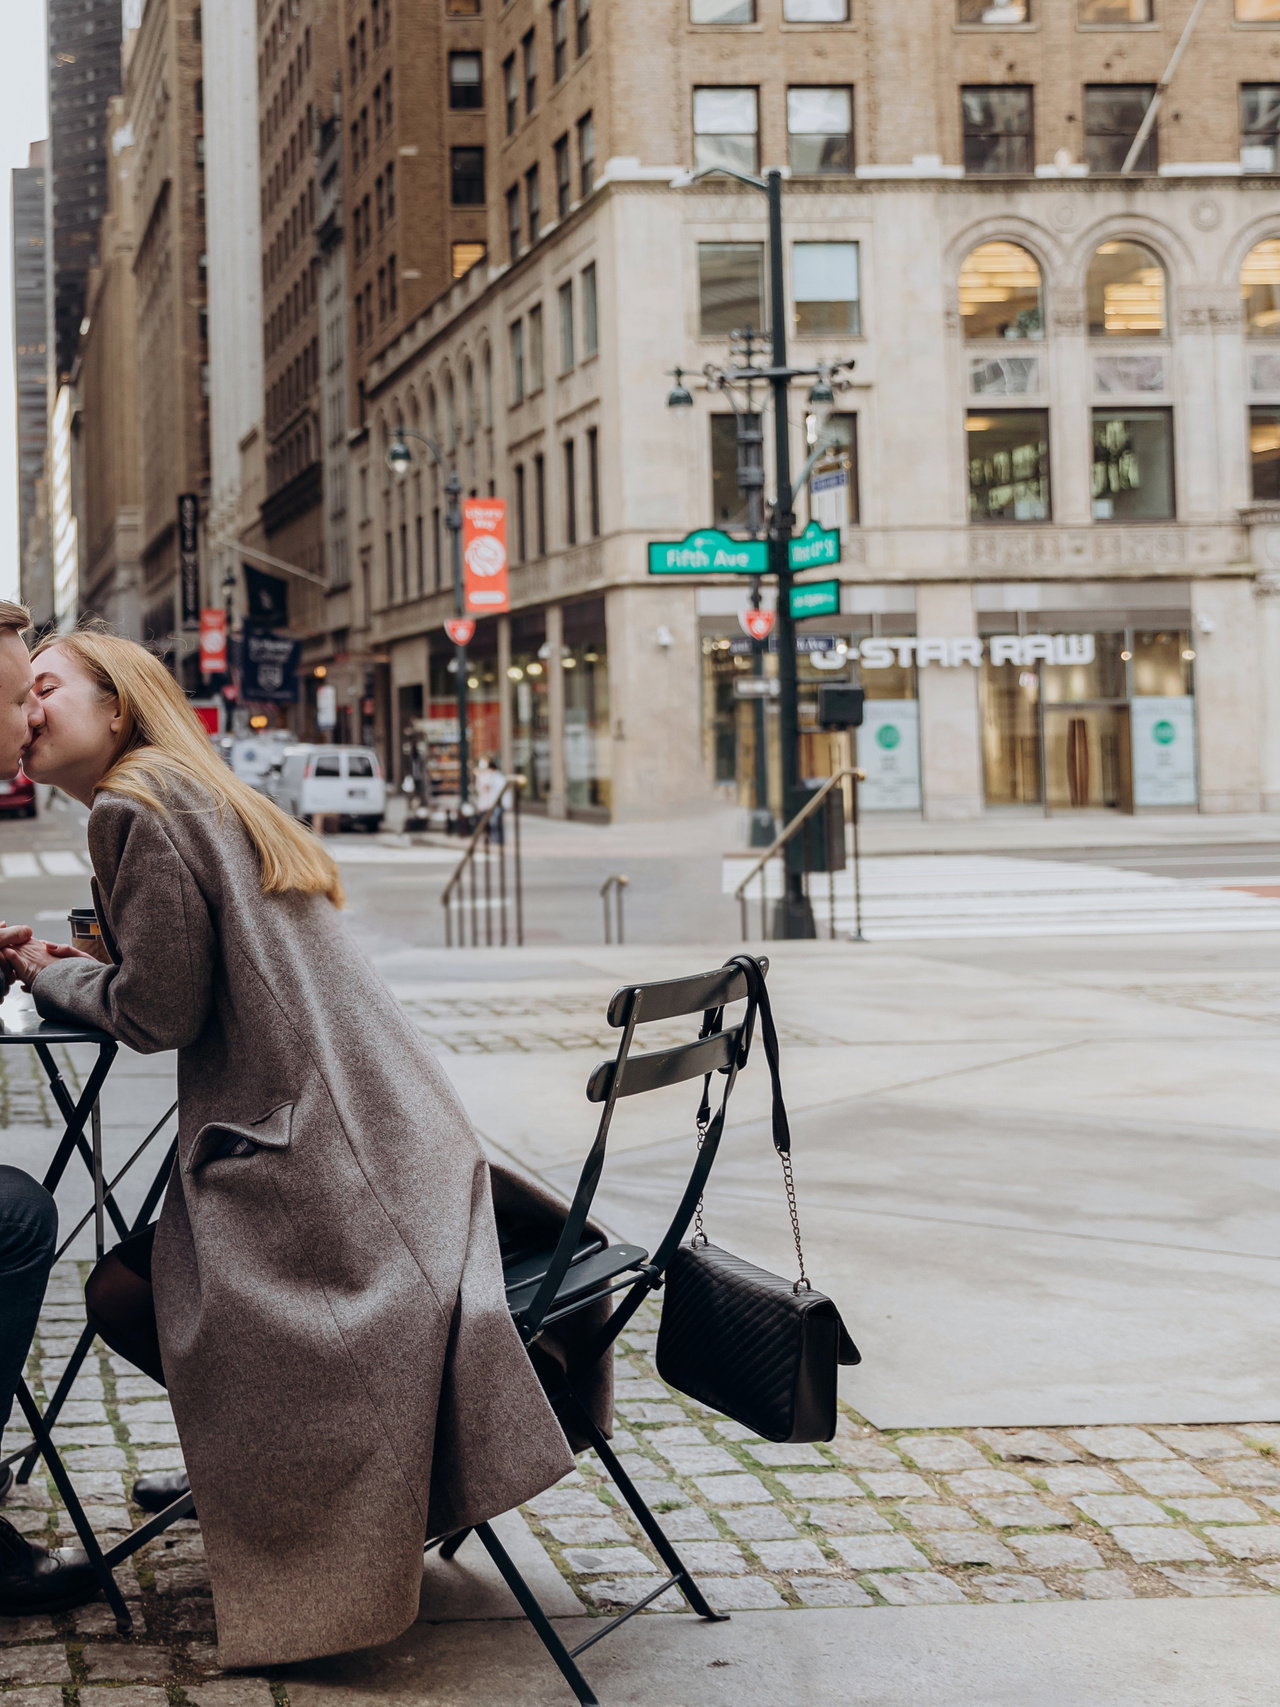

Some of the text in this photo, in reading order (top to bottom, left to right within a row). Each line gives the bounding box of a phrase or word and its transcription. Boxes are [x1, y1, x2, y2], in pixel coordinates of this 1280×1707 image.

[666, 549, 750, 568] Fifth Ave
[810, 633, 1096, 669] G-STAR RAW
